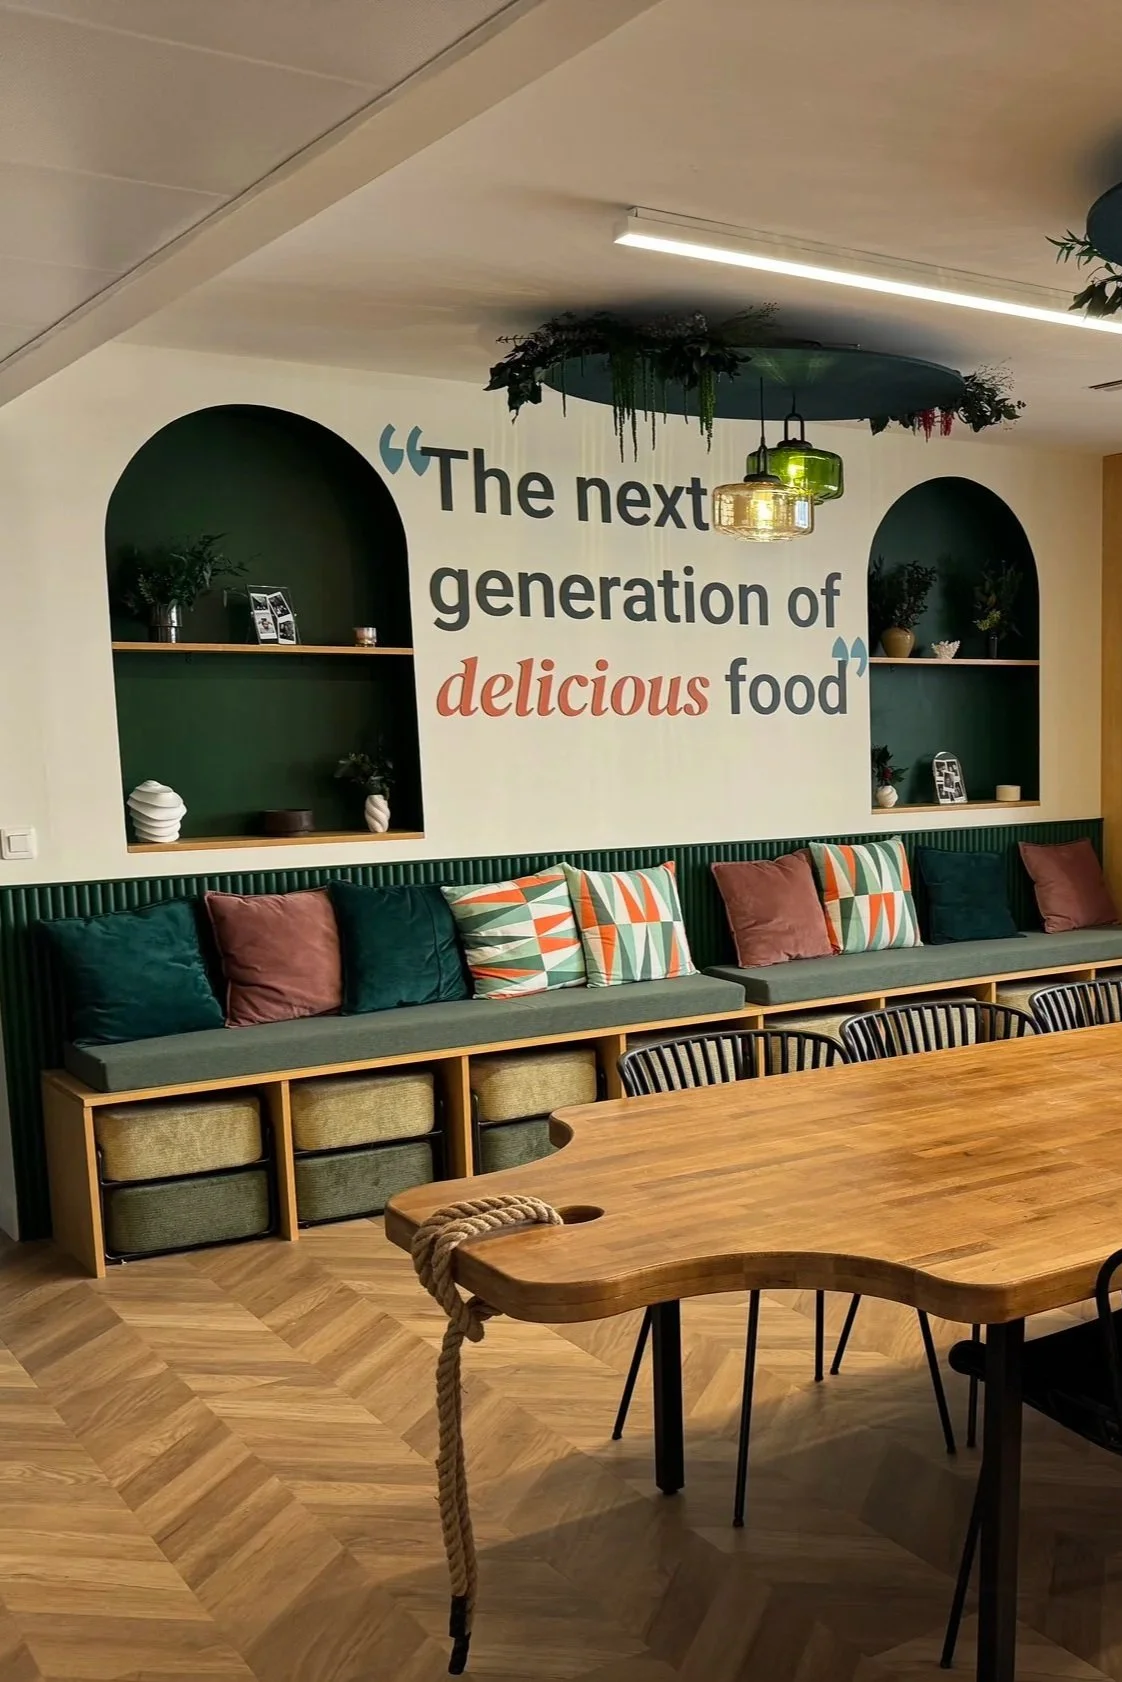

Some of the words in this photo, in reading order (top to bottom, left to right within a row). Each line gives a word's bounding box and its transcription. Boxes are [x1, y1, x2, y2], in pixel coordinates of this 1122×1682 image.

[576, 477, 709, 531] next
[429, 565, 769, 632] generation
[787, 572, 841, 629] of
[436, 655, 710, 717] delicious
